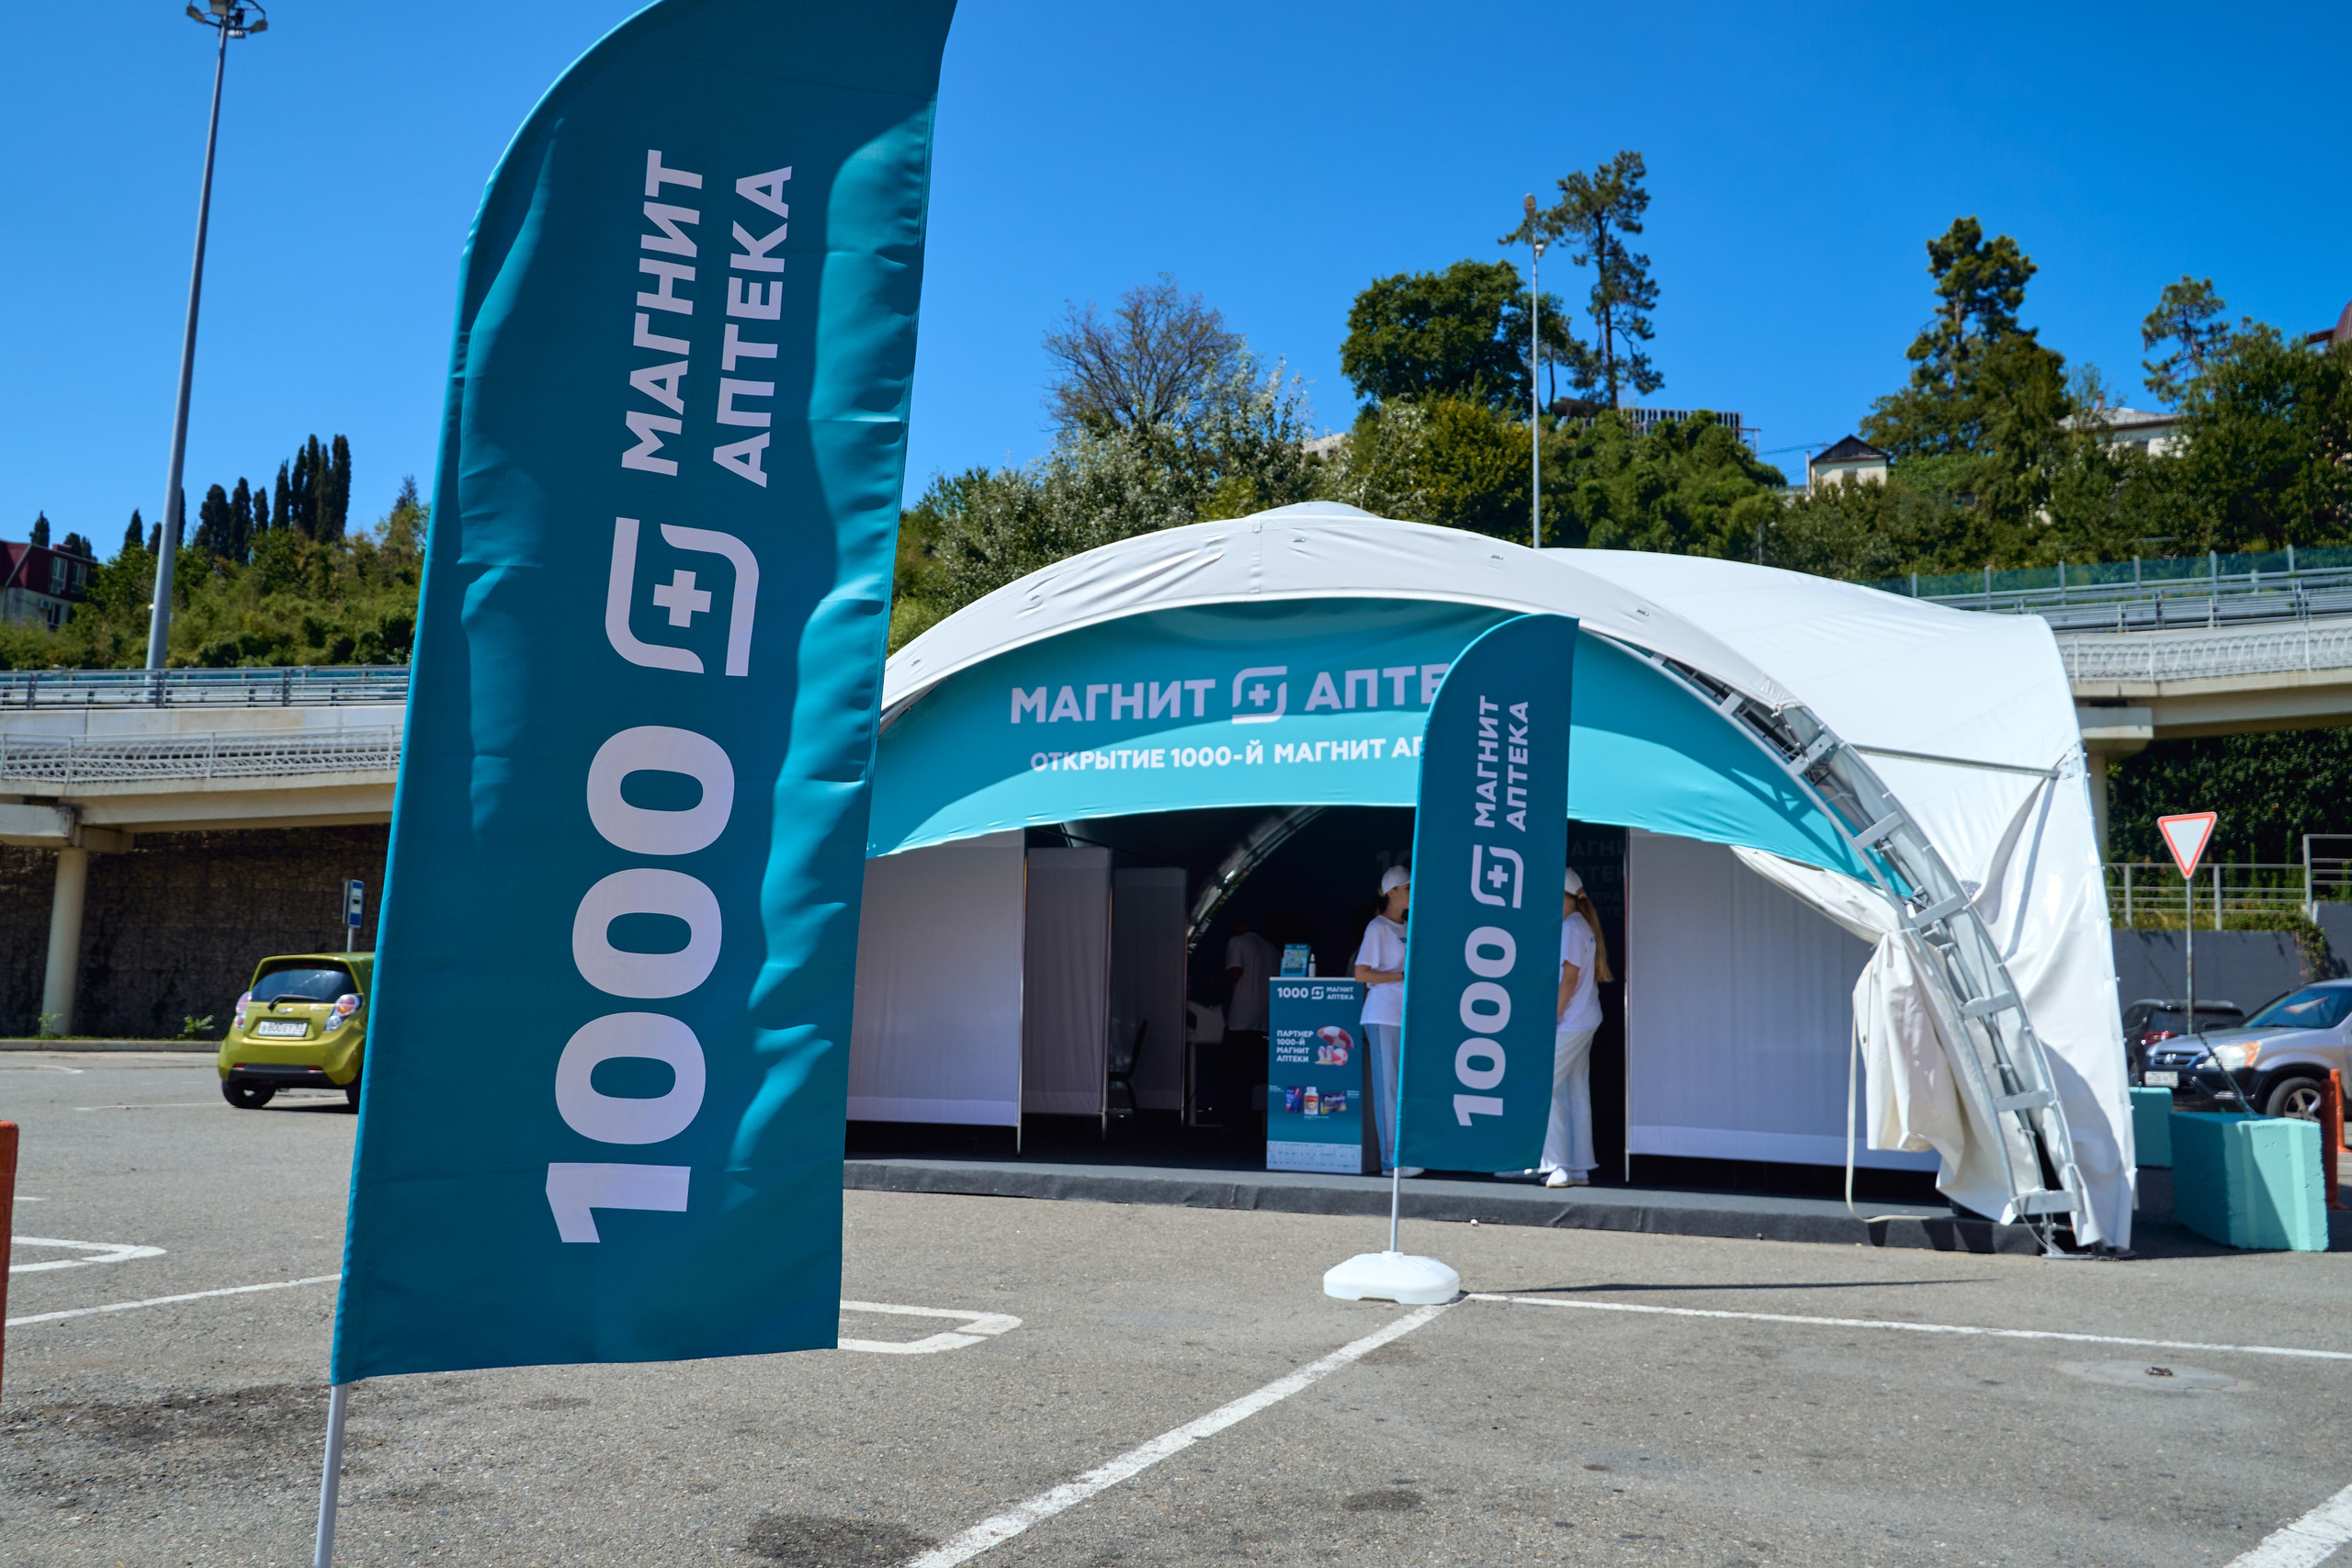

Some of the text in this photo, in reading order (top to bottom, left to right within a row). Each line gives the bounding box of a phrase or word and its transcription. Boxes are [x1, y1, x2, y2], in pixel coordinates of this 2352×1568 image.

[621, 149, 703, 477] МАГНИТ
[713, 165, 792, 488] АПТЕКА
[1011, 679, 1216, 724] МАГНИТ
[1030, 749, 1165, 772] ОТКРЫТИЕ
[1170, 739, 1263, 768] 1000-Й
[1274, 739, 1386, 763] МАГНИТ
[1474, 695, 1500, 828] МАГНИТ
[1506, 701, 1529, 832] АПТЕКА
[545, 725, 735, 1244] 1000
[1277, 987, 1309, 998] 1000
[1276, 1030, 1314, 1038] ПАРТНЕР
[1276, 1037, 1306, 1045] 1000-Й
[1453, 926, 1517, 1127] 1000
[1276, 1046, 1310, 1055] МАГНИТ
[1276, 1055, 1309, 1063] АПТЕКИ
